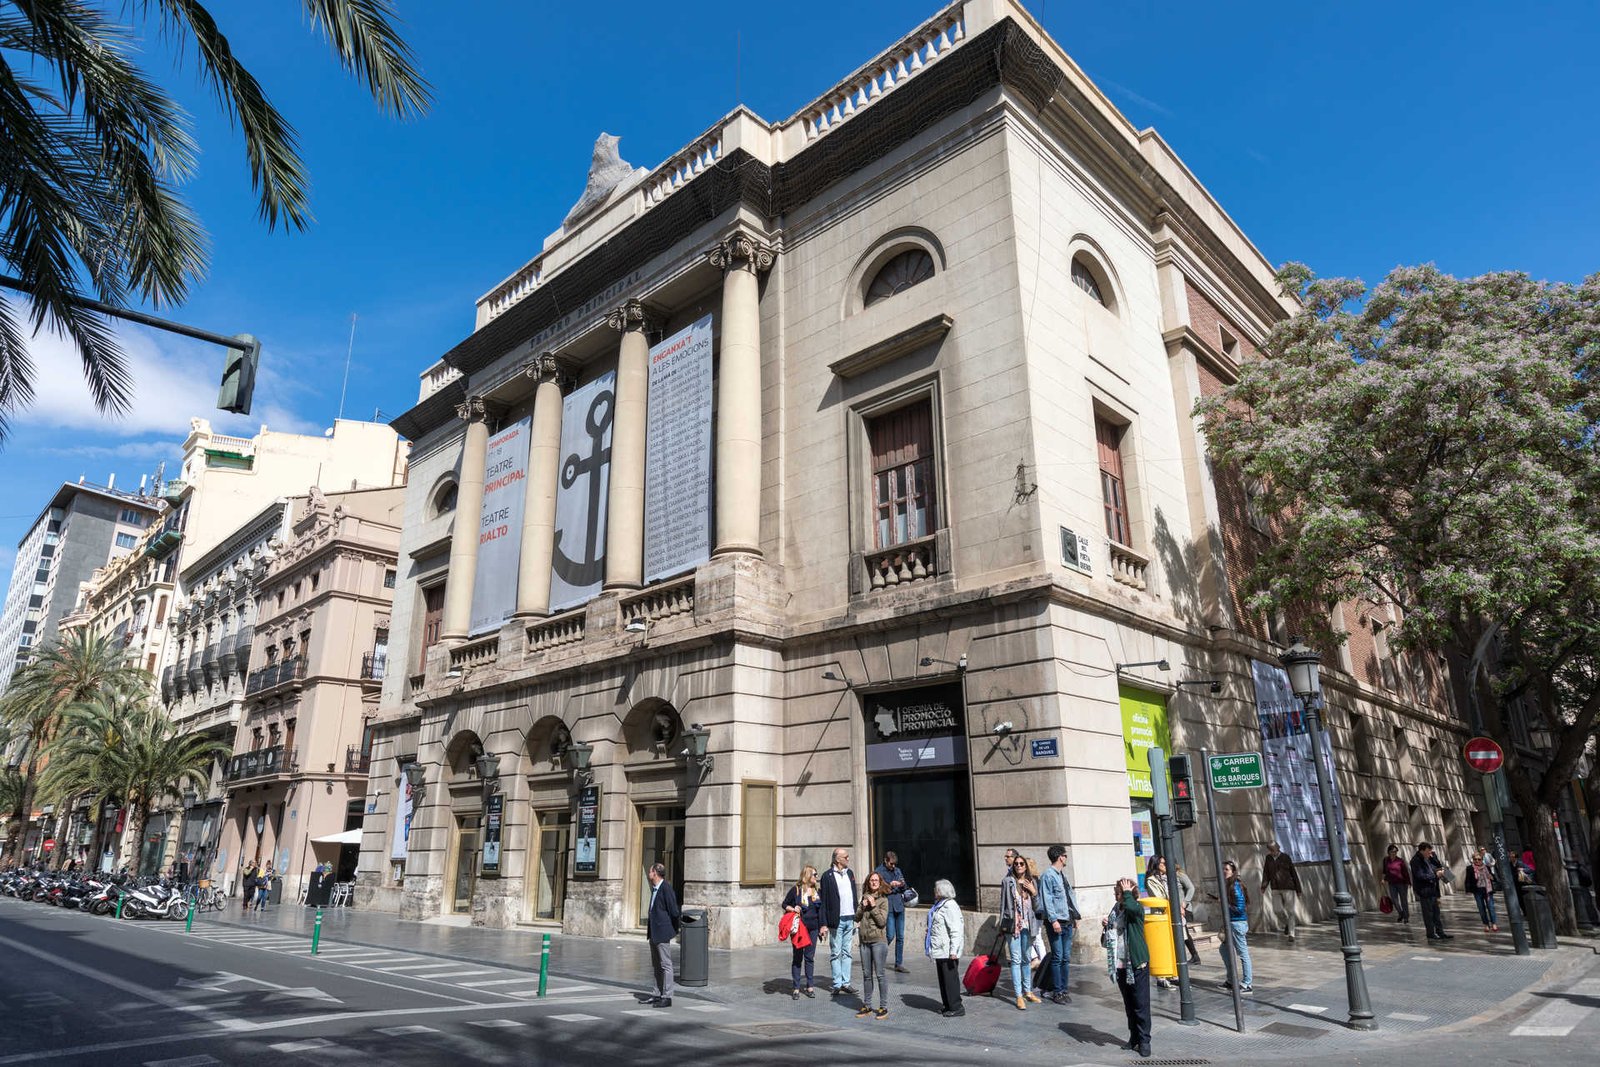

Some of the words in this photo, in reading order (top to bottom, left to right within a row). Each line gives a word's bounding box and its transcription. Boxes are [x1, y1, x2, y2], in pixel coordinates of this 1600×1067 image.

[529, 315, 571, 349] TEATRO
[577, 270, 643, 319] PRINCIPAL
[652, 336, 692, 364] ENGANXA'T
[652, 367, 658, 375] A
[658, 360, 671, 373] LES
[671, 338, 709, 365] EMOCIONS
[488, 428, 520, 450] TEMPORADA
[486, 457, 514, 479] TEATRE
[484, 467, 526, 496] PRINCIPAL
[481, 506, 510, 528] TEATRE
[480, 524, 509, 545] RIALTO
[902, 704, 932, 714] OFICINA
[902, 707, 952, 722] PROMOCIÓ
[902, 717, 958, 731] PROVINCIAL
[1223, 756, 1256, 766] CARRER
[1214, 775, 1227, 783] LES
[1227, 773, 1260, 782] BARQUES
